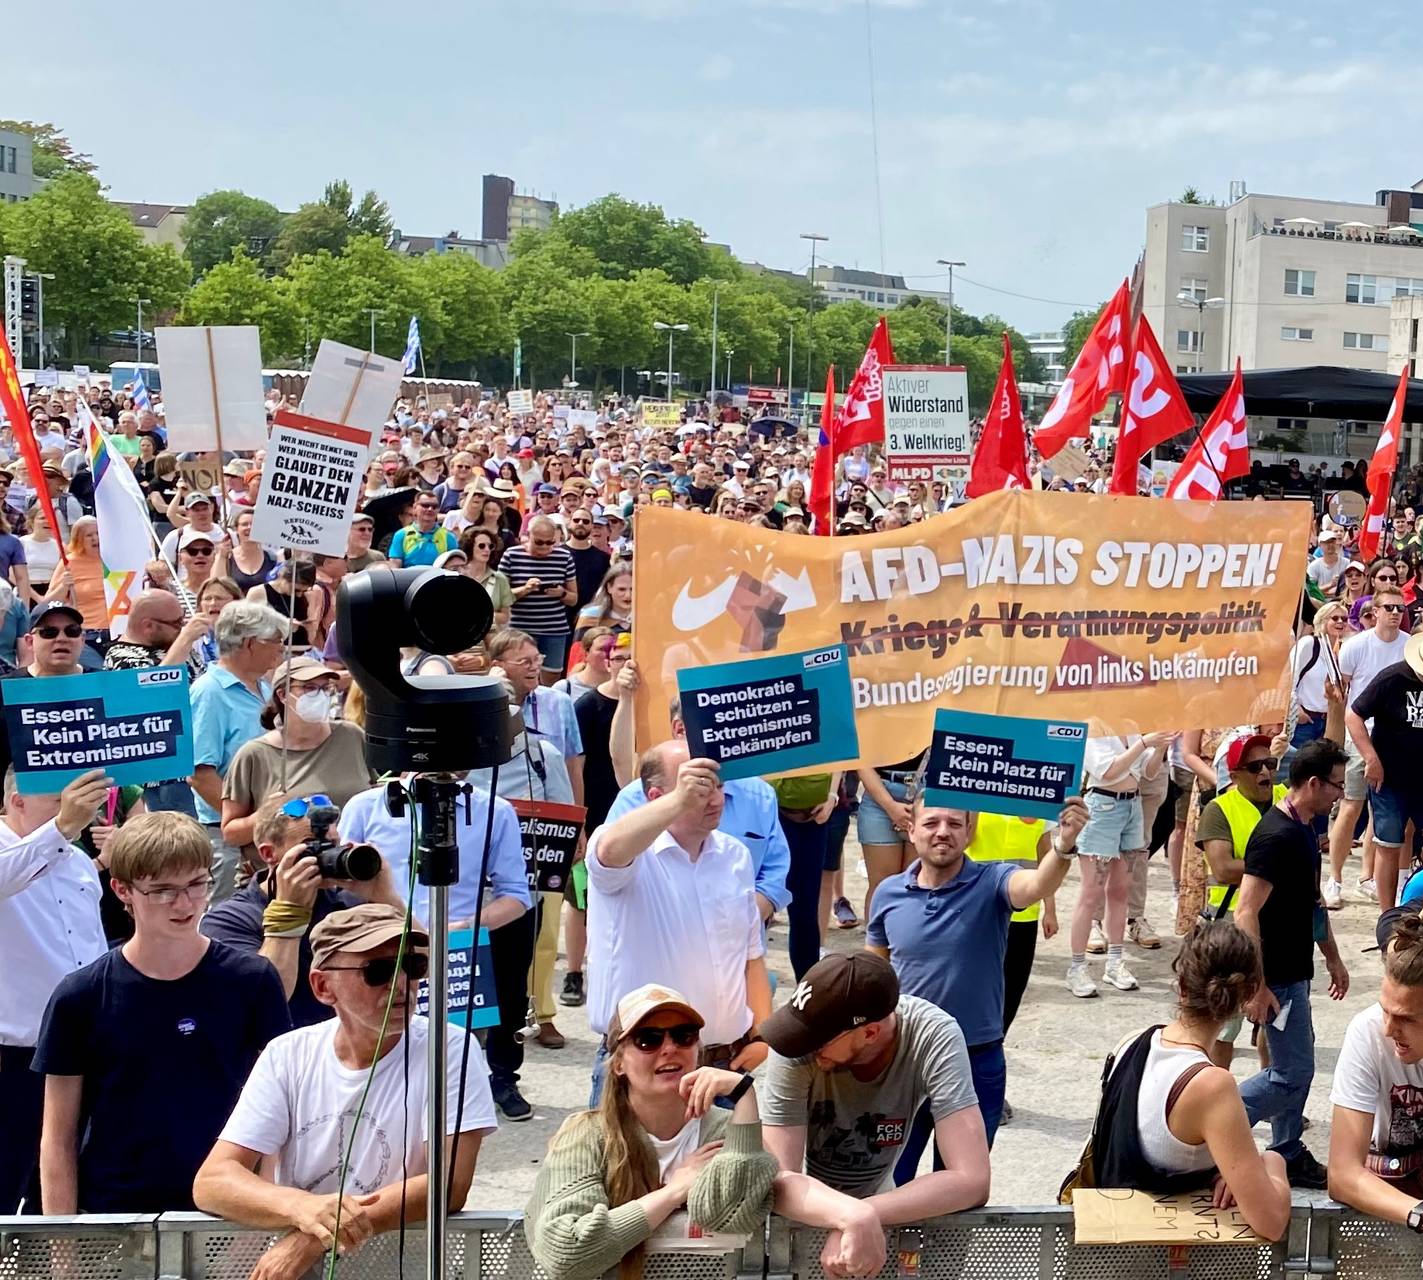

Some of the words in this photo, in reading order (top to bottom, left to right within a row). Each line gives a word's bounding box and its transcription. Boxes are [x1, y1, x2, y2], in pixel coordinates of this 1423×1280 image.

[887, 375, 930, 393] Aktiver
[887, 396, 964, 413] Widerstand
[888, 417, 918, 430] gegen
[919, 417, 945, 429] einen
[278, 444, 297, 454] WER
[297, 448, 327, 462] NICHTS
[280, 434, 297, 445] WER
[297, 439, 320, 449] NICHT
[320, 443, 343, 456] DENKT
[343, 449, 358, 458] UND
[890, 434, 902, 450] 3.
[903, 434, 966, 452] Weltkrieg!
[181, 469, 220, 490] NO!
[275, 455, 327, 477] GLAUBT
[327, 467, 353, 483] DEN
[891, 467, 931, 480] MLPD
[271, 472, 349, 505] GANZEN
[267, 494, 344, 520] NAZI-SCHEISS
[280, 532, 320, 545] WELCOME
[839, 535, 1083, 604] AFD-NAZIS
[1090, 542, 1283, 589] STOPPEN!
[998, 601, 1267, 644] Verarmungspolitik
[814, 650, 839, 664] CDU
[150, 671, 180, 682] CDU
[853, 663, 1048, 710] Bundesregierung
[1055, 664, 1093, 688] von
[1097, 655, 1144, 686] links
[1149, 654, 1259, 684] bekämpfen
[697, 680, 796, 707] Demokratie
[21, 706, 95, 725] Essen:
[714, 699, 792, 723] schützen
[33, 727, 83, 746] Kein
[87, 722, 139, 741] Platz
[142, 716, 173, 735] für
[702, 713, 812, 743] Extremismus
[1057, 727, 1082, 737] CDU
[26, 740, 167, 767] Extremismus
[719, 730, 812, 758] bekämpfen
[944, 735, 1004, 757] Essen:
[949, 754, 989, 773] Kein
[992, 760, 1036, 779] Platz
[1039, 765, 1066, 782] für
[938, 771, 1056, 799] Extremismus
[520, 818, 577, 839] alismus
[536, 844, 565, 863] den
[876, 1123, 903, 1134] FCK
[876, 1132, 903, 1142] AFD
